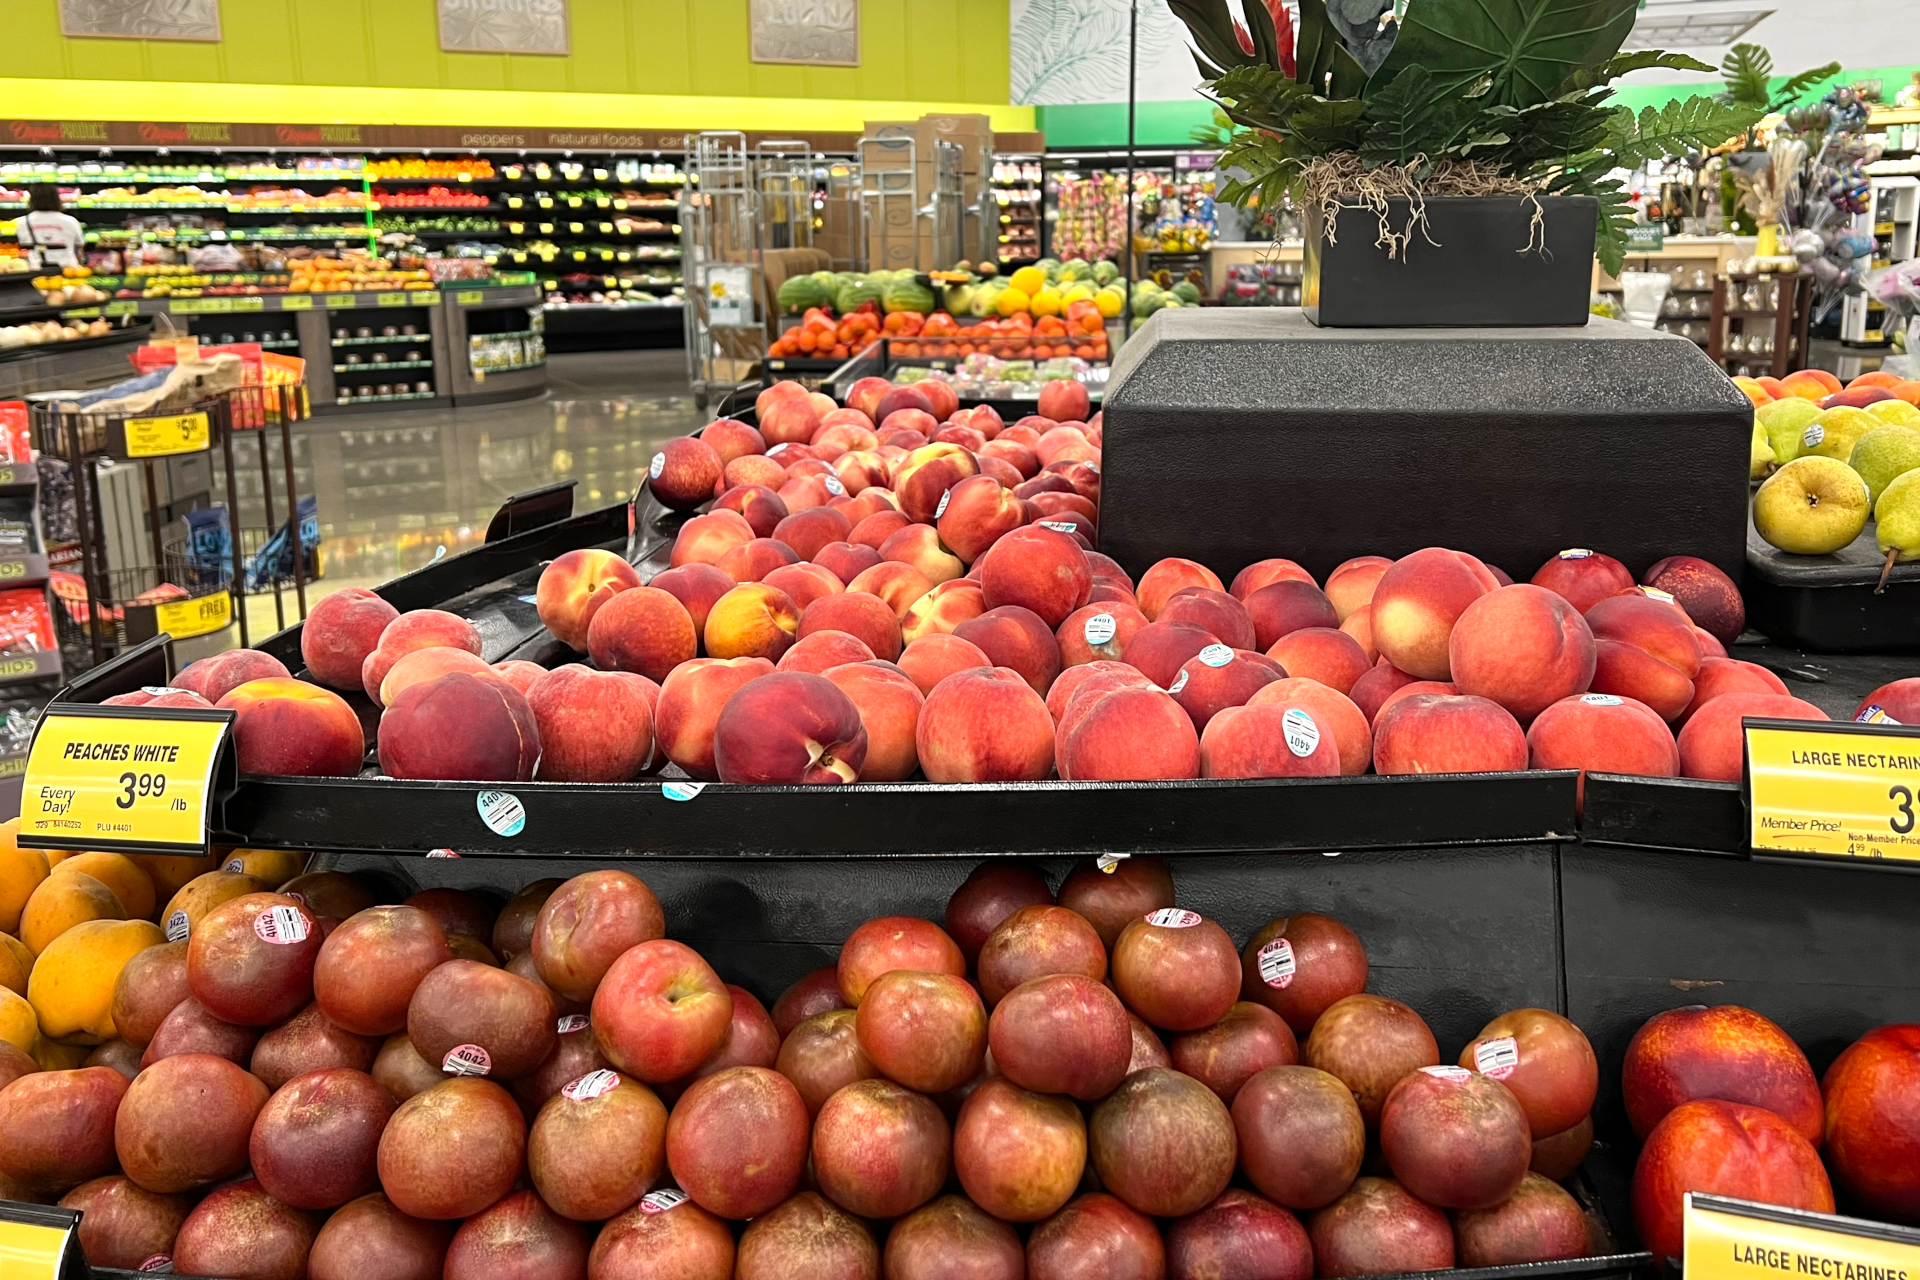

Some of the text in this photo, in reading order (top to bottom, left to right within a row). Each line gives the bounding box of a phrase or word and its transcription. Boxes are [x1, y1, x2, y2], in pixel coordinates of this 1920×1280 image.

[320, 125, 361, 142] PRODUCE
[461, 134, 525, 147] peppers
[548, 133, 645, 147] natural foods
[200, 598, 226, 618] FREE
[1290, 735, 1310, 751] 4401
[63, 742, 180, 763] PEACHES WHITE
[1791, 750, 1842, 766] LARGE
[40, 786, 75, 801] Every
[482, 790, 504, 808] 4401
[42, 800, 71, 815] Day!
[170, 798, 187, 811] /lb
[1888, 784, 1920, 834] 3
[97, 823, 111, 831] PLU
[112, 823, 132, 832] #4401
[1761, 817, 1842, 832] Member Price!
[1848, 833, 1899, 845] Non-Member
[169, 915, 185, 930] 3422
[261, 913, 277, 938] 4042
[1263, 941, 1285, 954] 4042
[457, 1049, 487, 1066] 4042
[1733, 1243, 1791, 1271] LARGE
